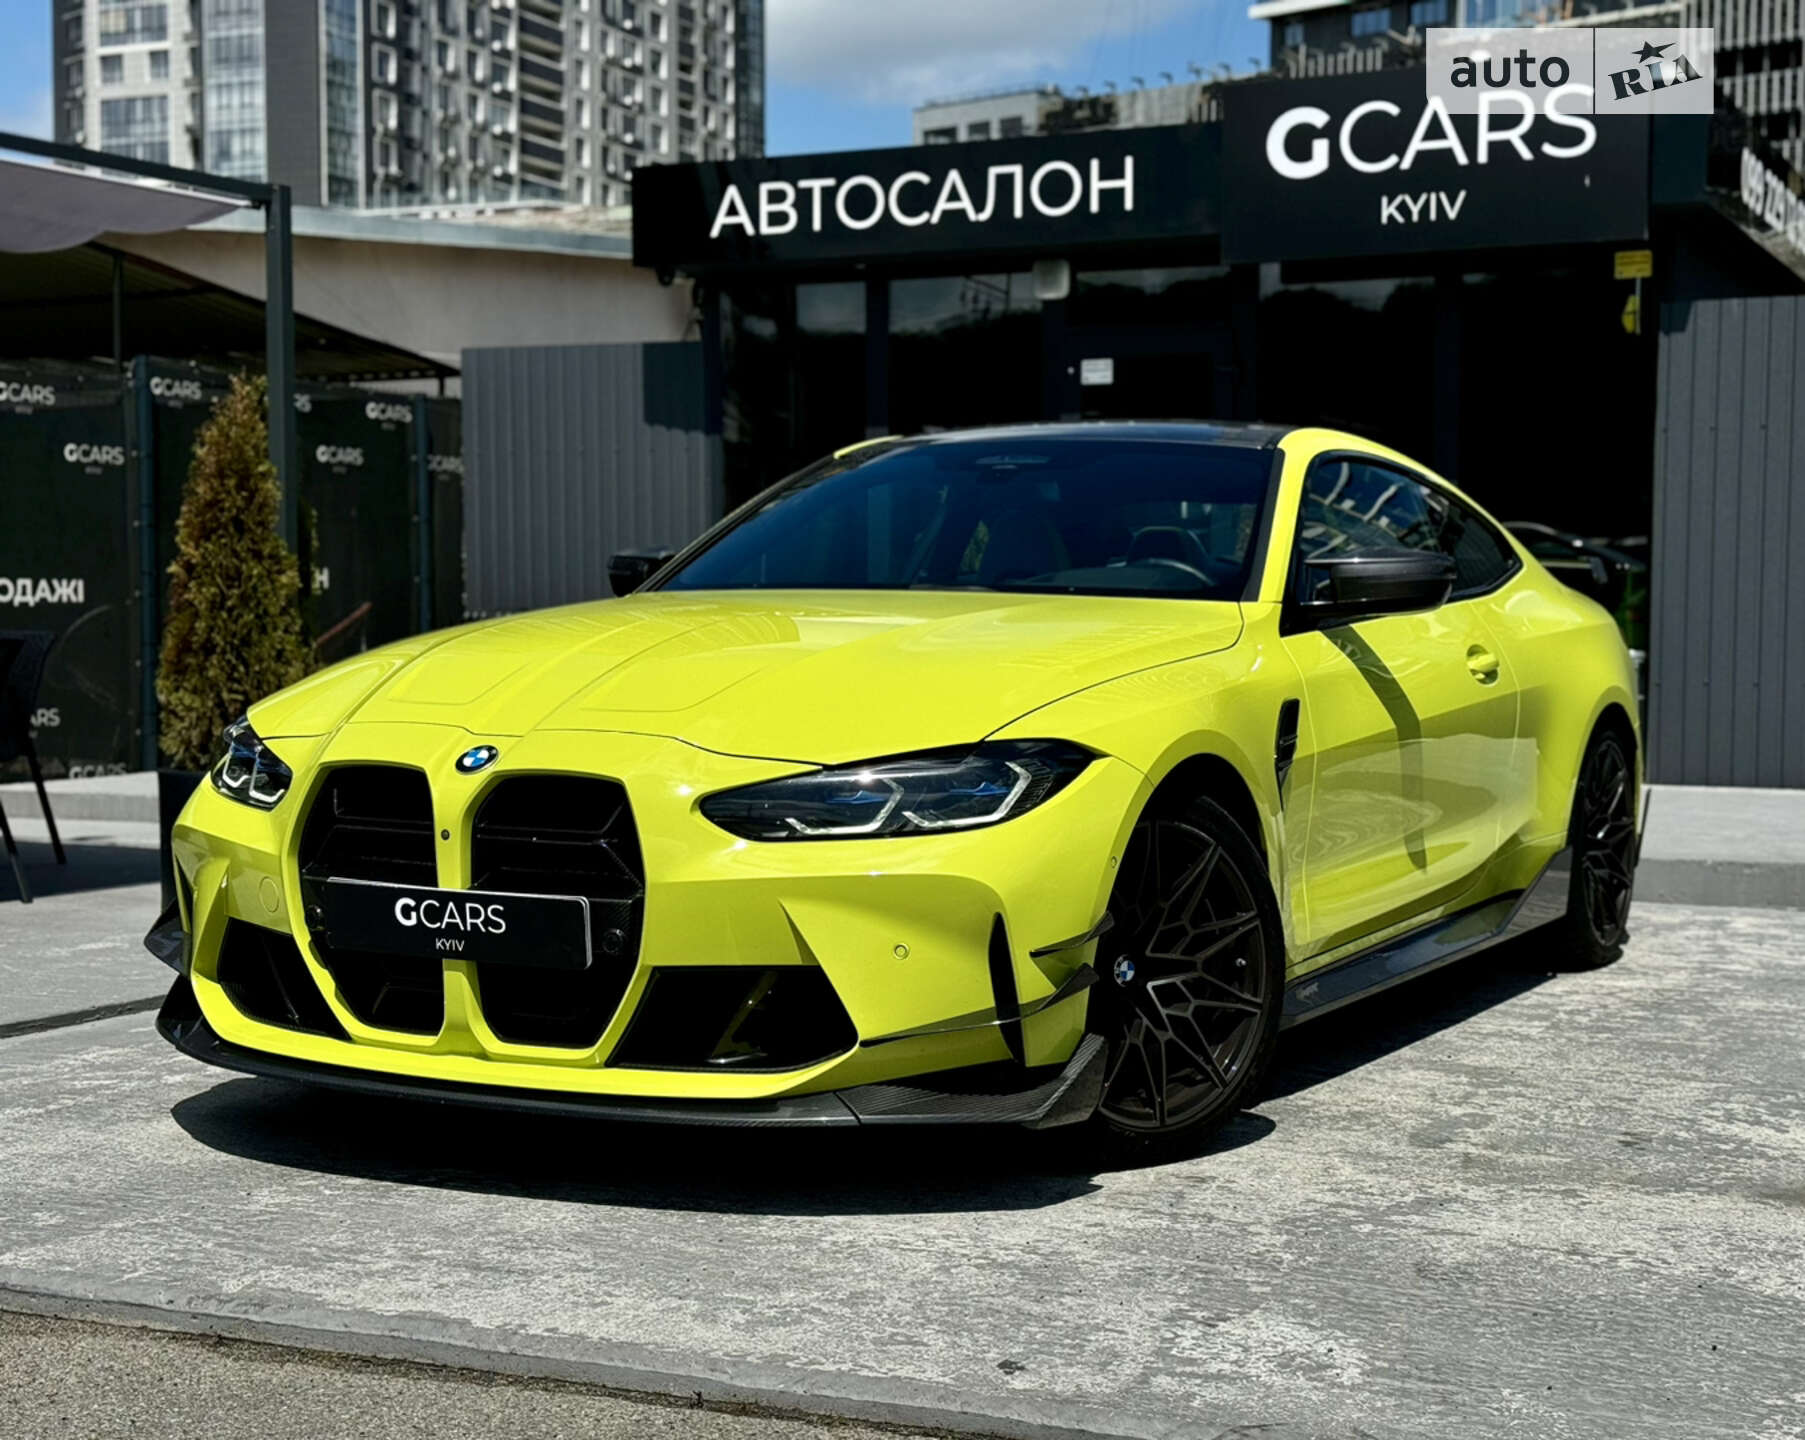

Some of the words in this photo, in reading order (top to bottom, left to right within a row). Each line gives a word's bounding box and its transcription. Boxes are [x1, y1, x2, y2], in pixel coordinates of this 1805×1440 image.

[1265, 84, 1597, 180] GCARS
[709, 154, 1134, 239] АВТОСАЛОН
[1380, 189, 1467, 225] KYIV
[150, 376, 202, 400] GCARS
[365, 401, 413, 423] GCARS
[63, 442, 125, 466] GCARS
[315, 444, 364, 466] GCARS
[394, 897, 506, 934] GCARS
[435, 937, 465, 952] KYIV
